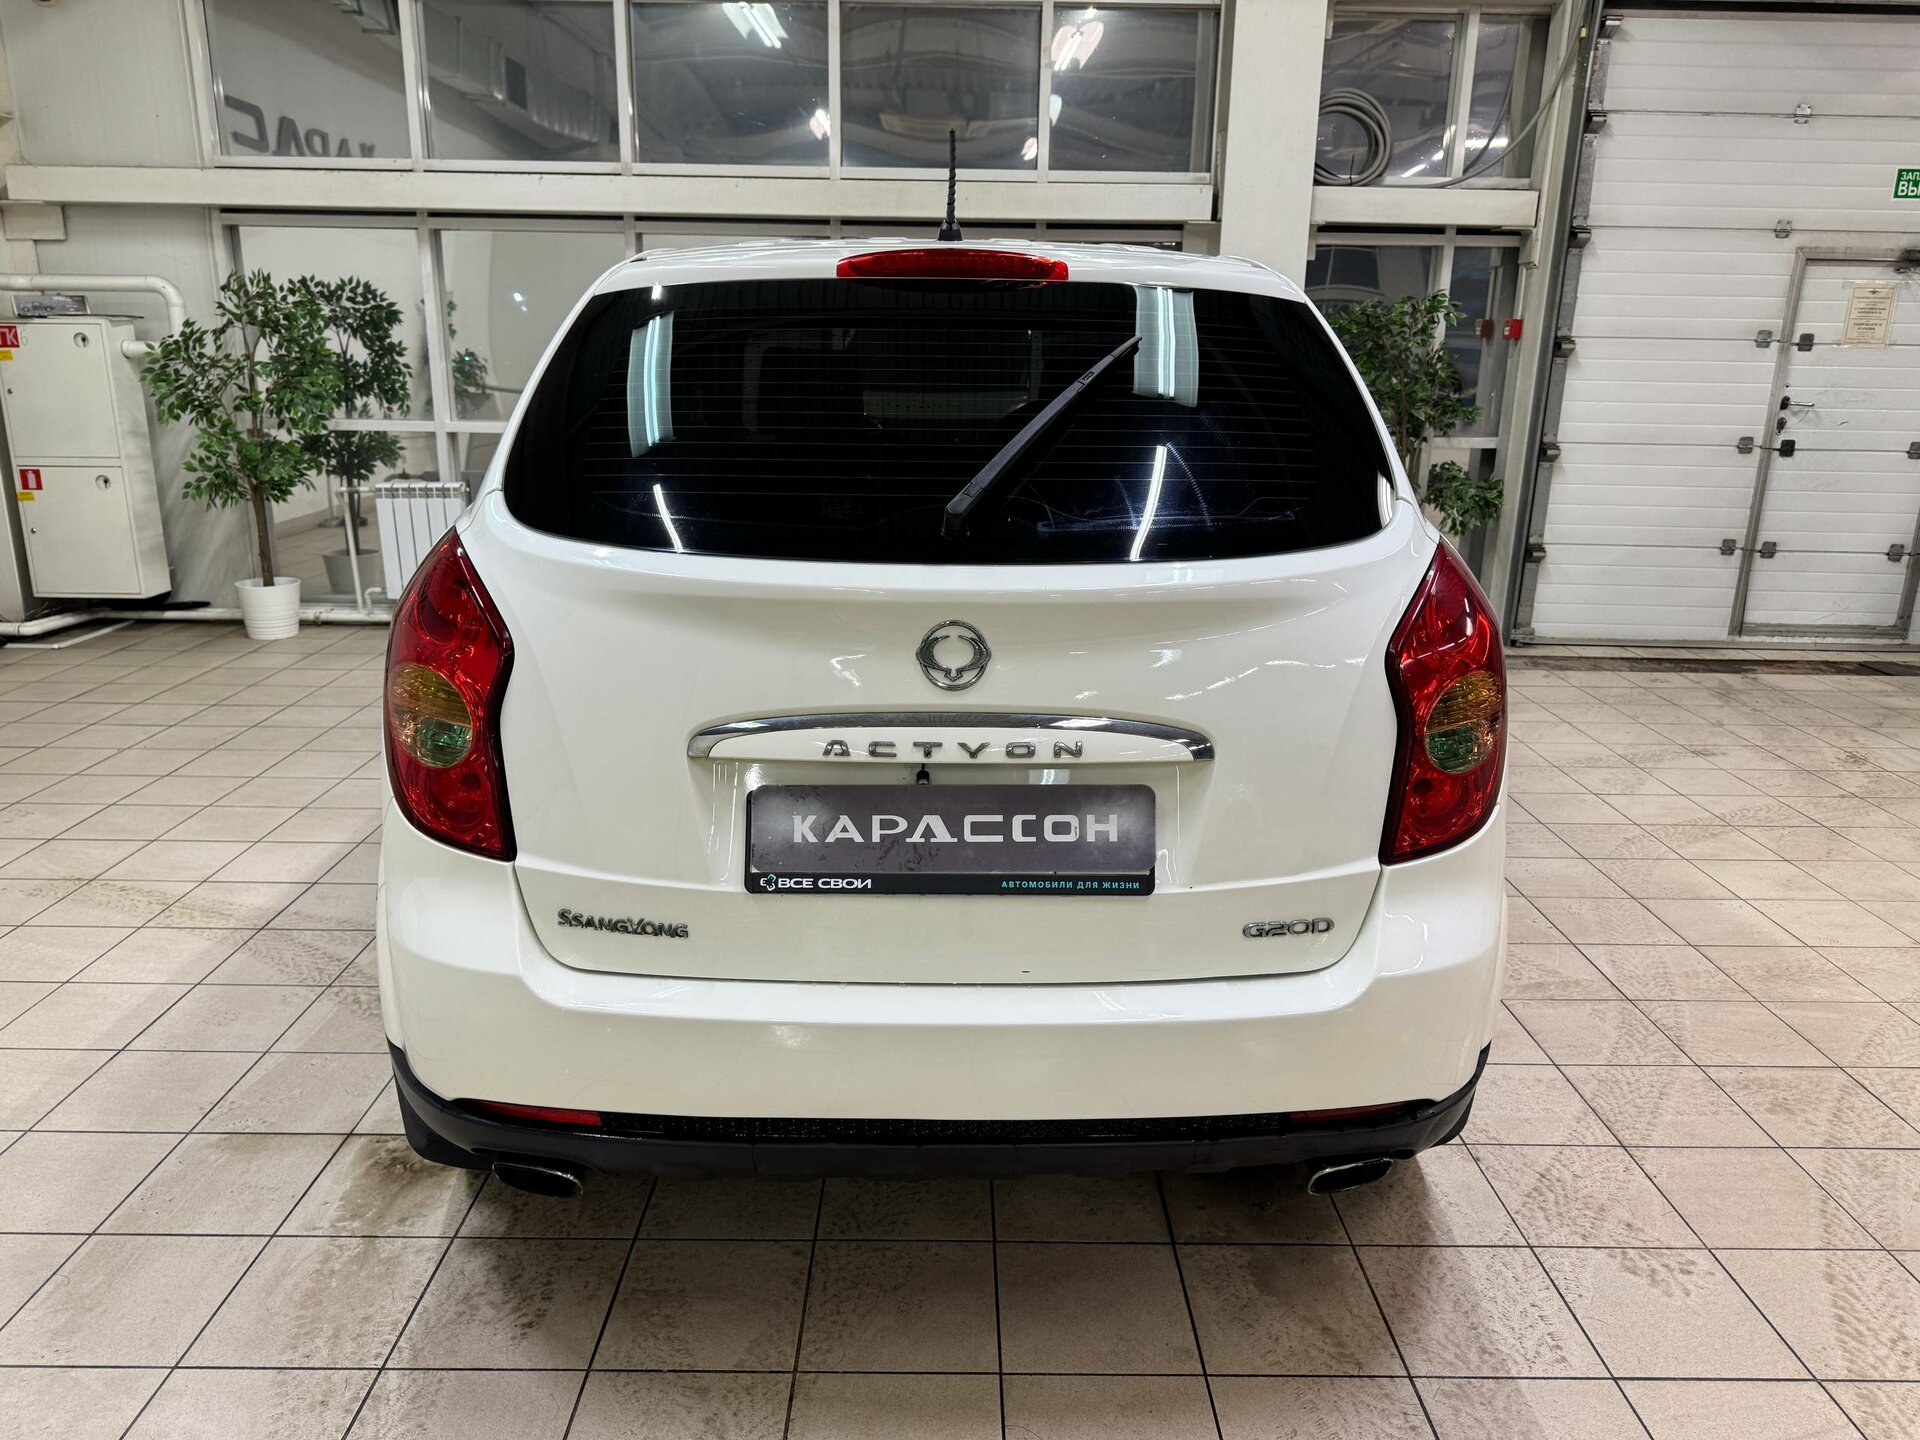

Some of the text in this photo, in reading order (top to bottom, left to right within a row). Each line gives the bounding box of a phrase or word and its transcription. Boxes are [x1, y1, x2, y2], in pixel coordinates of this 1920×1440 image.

[1900, 171, 1920, 180] ЗАП
[822, 739, 1083, 759] ACTYON
[778, 878, 872, 889] ВСЕ СВОИ
[1001, 881, 1140, 890] АВТОМОБИЛИ ДЛЯ ЖИЗНИ
[1243, 918, 1335, 938] G20D
